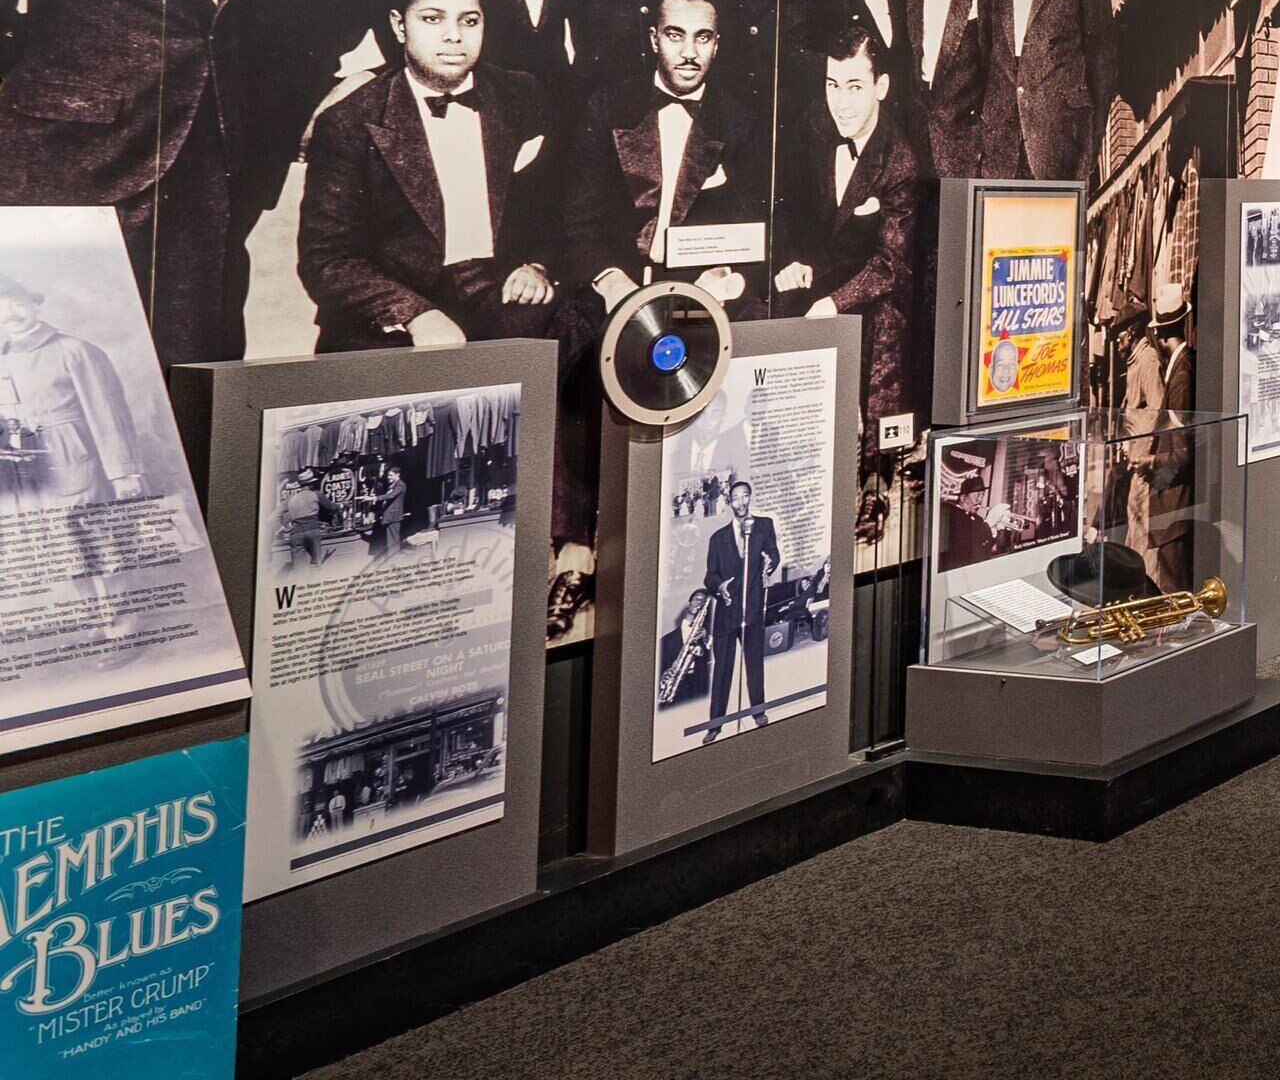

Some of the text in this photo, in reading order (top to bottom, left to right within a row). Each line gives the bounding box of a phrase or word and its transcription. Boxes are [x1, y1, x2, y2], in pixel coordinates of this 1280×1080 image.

[1006, 258, 1054, 282] JIMMIE
[993, 280, 1066, 309] LUNCEFORD'S
[991, 305, 1066, 332] ALL STARS
[1031, 341, 1059, 362] JOE
[1019, 357, 1068, 383] THOMAS
[390, 658, 430, 678] STREET
[432, 654, 453, 666] ON
[426, 660, 465, 679] NIGHT
[1, 815, 67, 857] THE
[0, 885, 222, 1016] BLUES
[83, 966, 173, 1004] Better known as
[103, 1003, 168, 1032] As played by
[115, 1021, 143, 1040] AND
[146, 1012, 168, 1028] HIS
